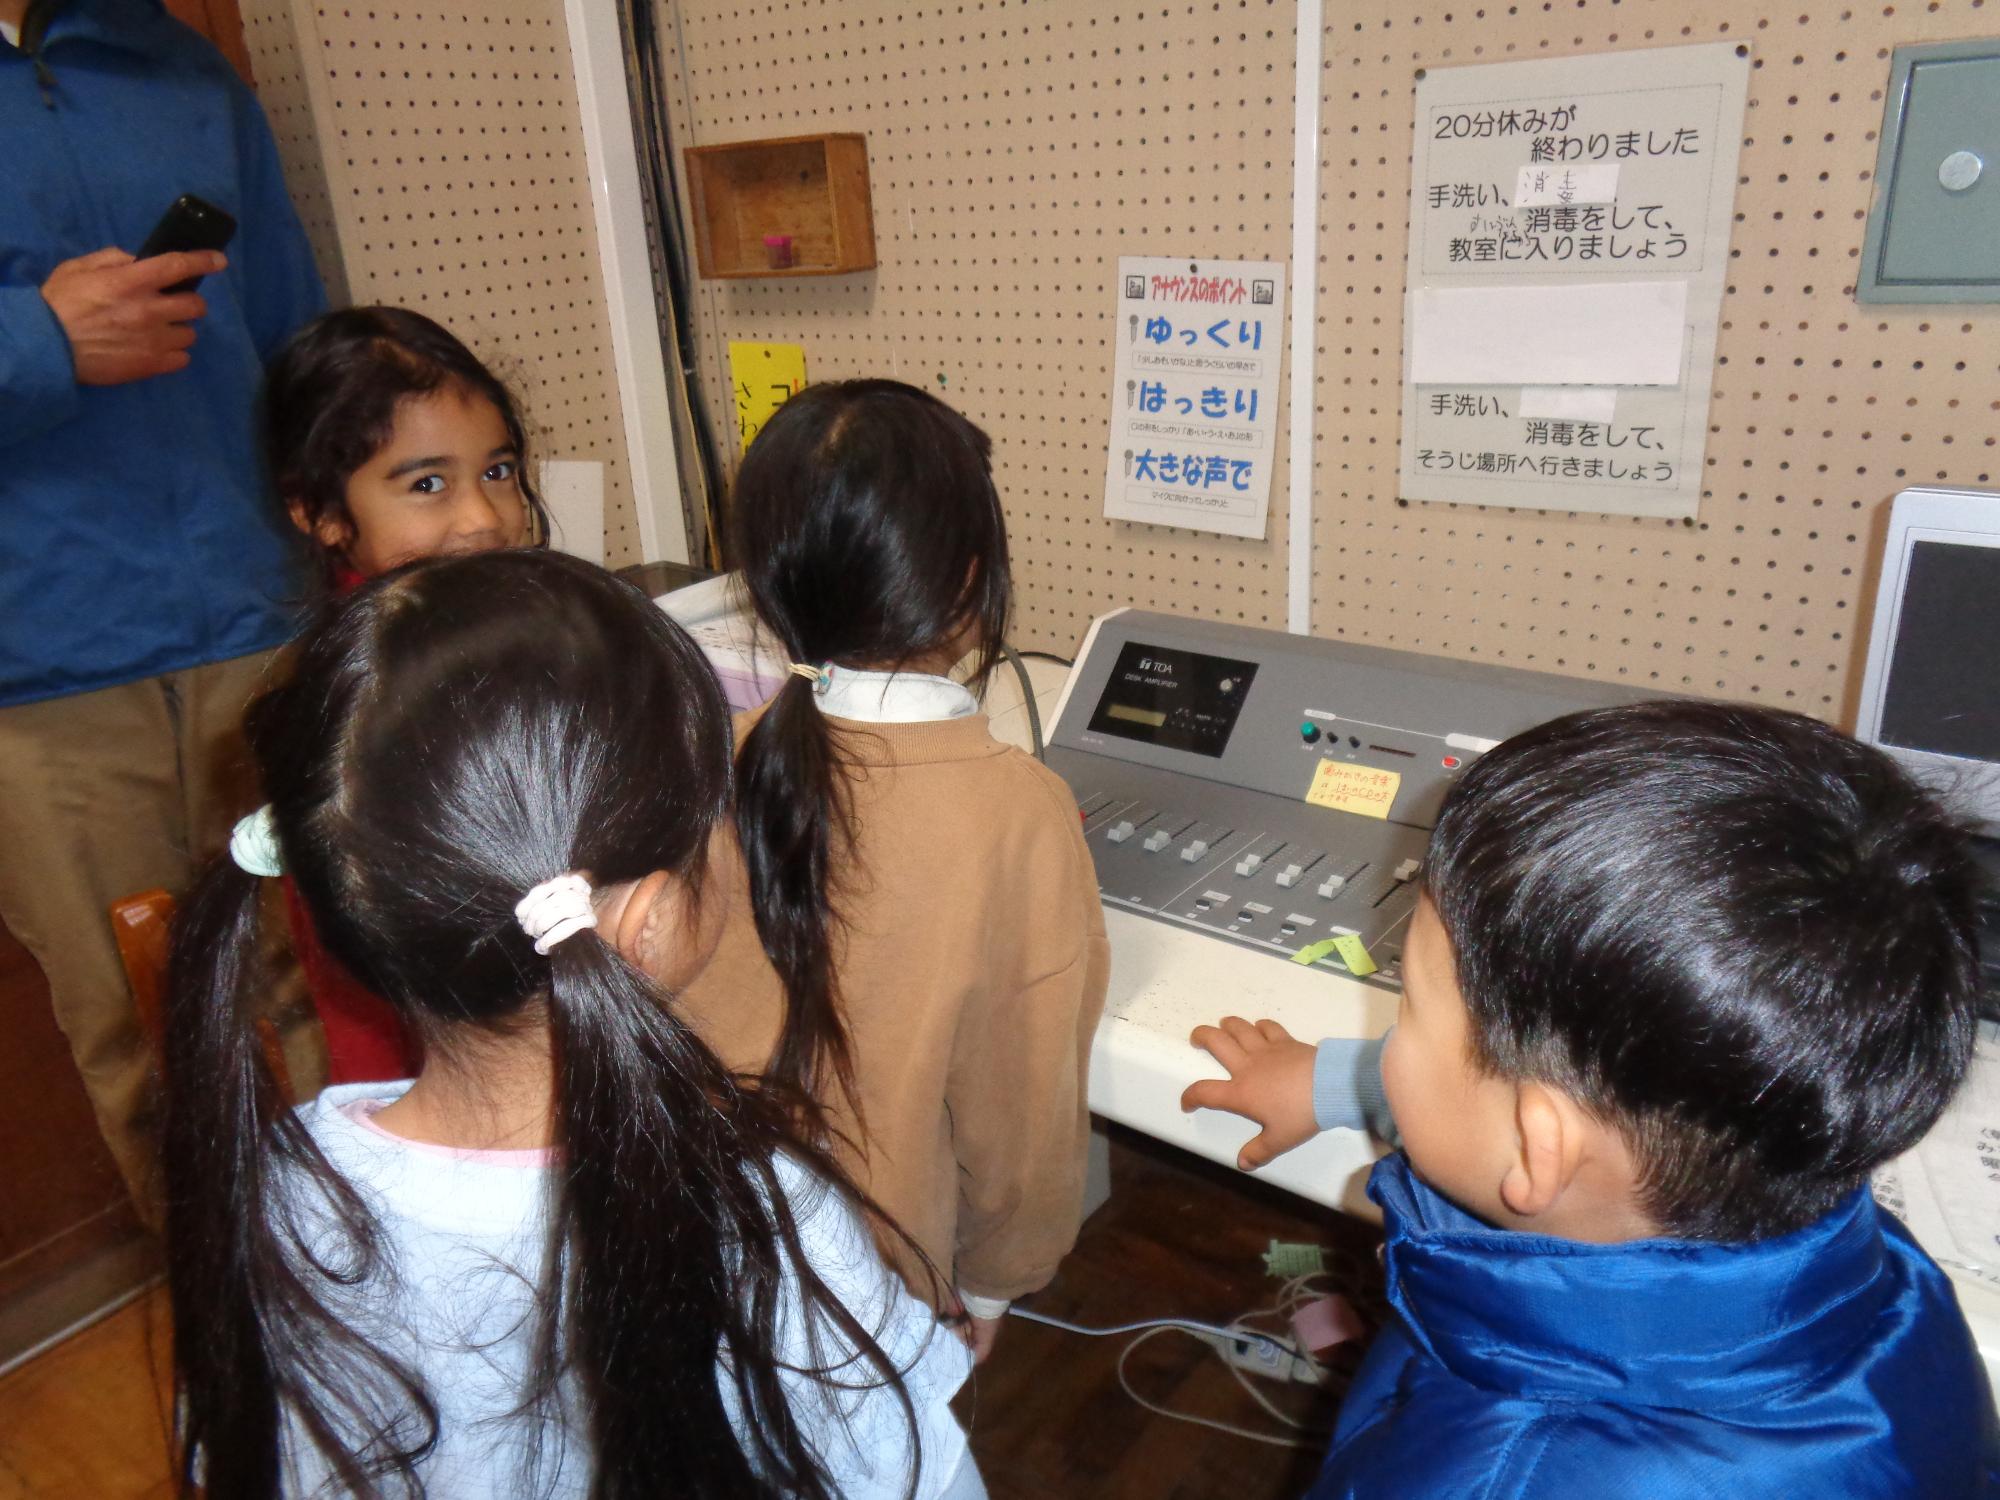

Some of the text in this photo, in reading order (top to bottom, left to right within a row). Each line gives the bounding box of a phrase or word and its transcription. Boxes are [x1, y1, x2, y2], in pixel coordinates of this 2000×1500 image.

[1435, 104, 1577, 139] 20分休みが
[1530, 127, 1700, 163] 終わりました
[1428, 183, 1510, 209] 手洗い、
[1525, 205, 1674, 233] 消毒をして、
[1449, 233, 1689, 263] 教室に入りましょう
[1151, 275, 1247, 304] アナウンスのポイント
[1145, 315, 1262, 350] ゆっくり
[1139, 380, 1258, 421] はっきり
[1430, 393, 1510, 418] 手洗い、
[1525, 421, 1667, 451] 消毒をして、
[1135, 448, 1253, 491] 大きな声で
[1417, 448, 1674, 482] そうじ場所へ行きましょう
[1153, 662, 1173, 673] TOA
